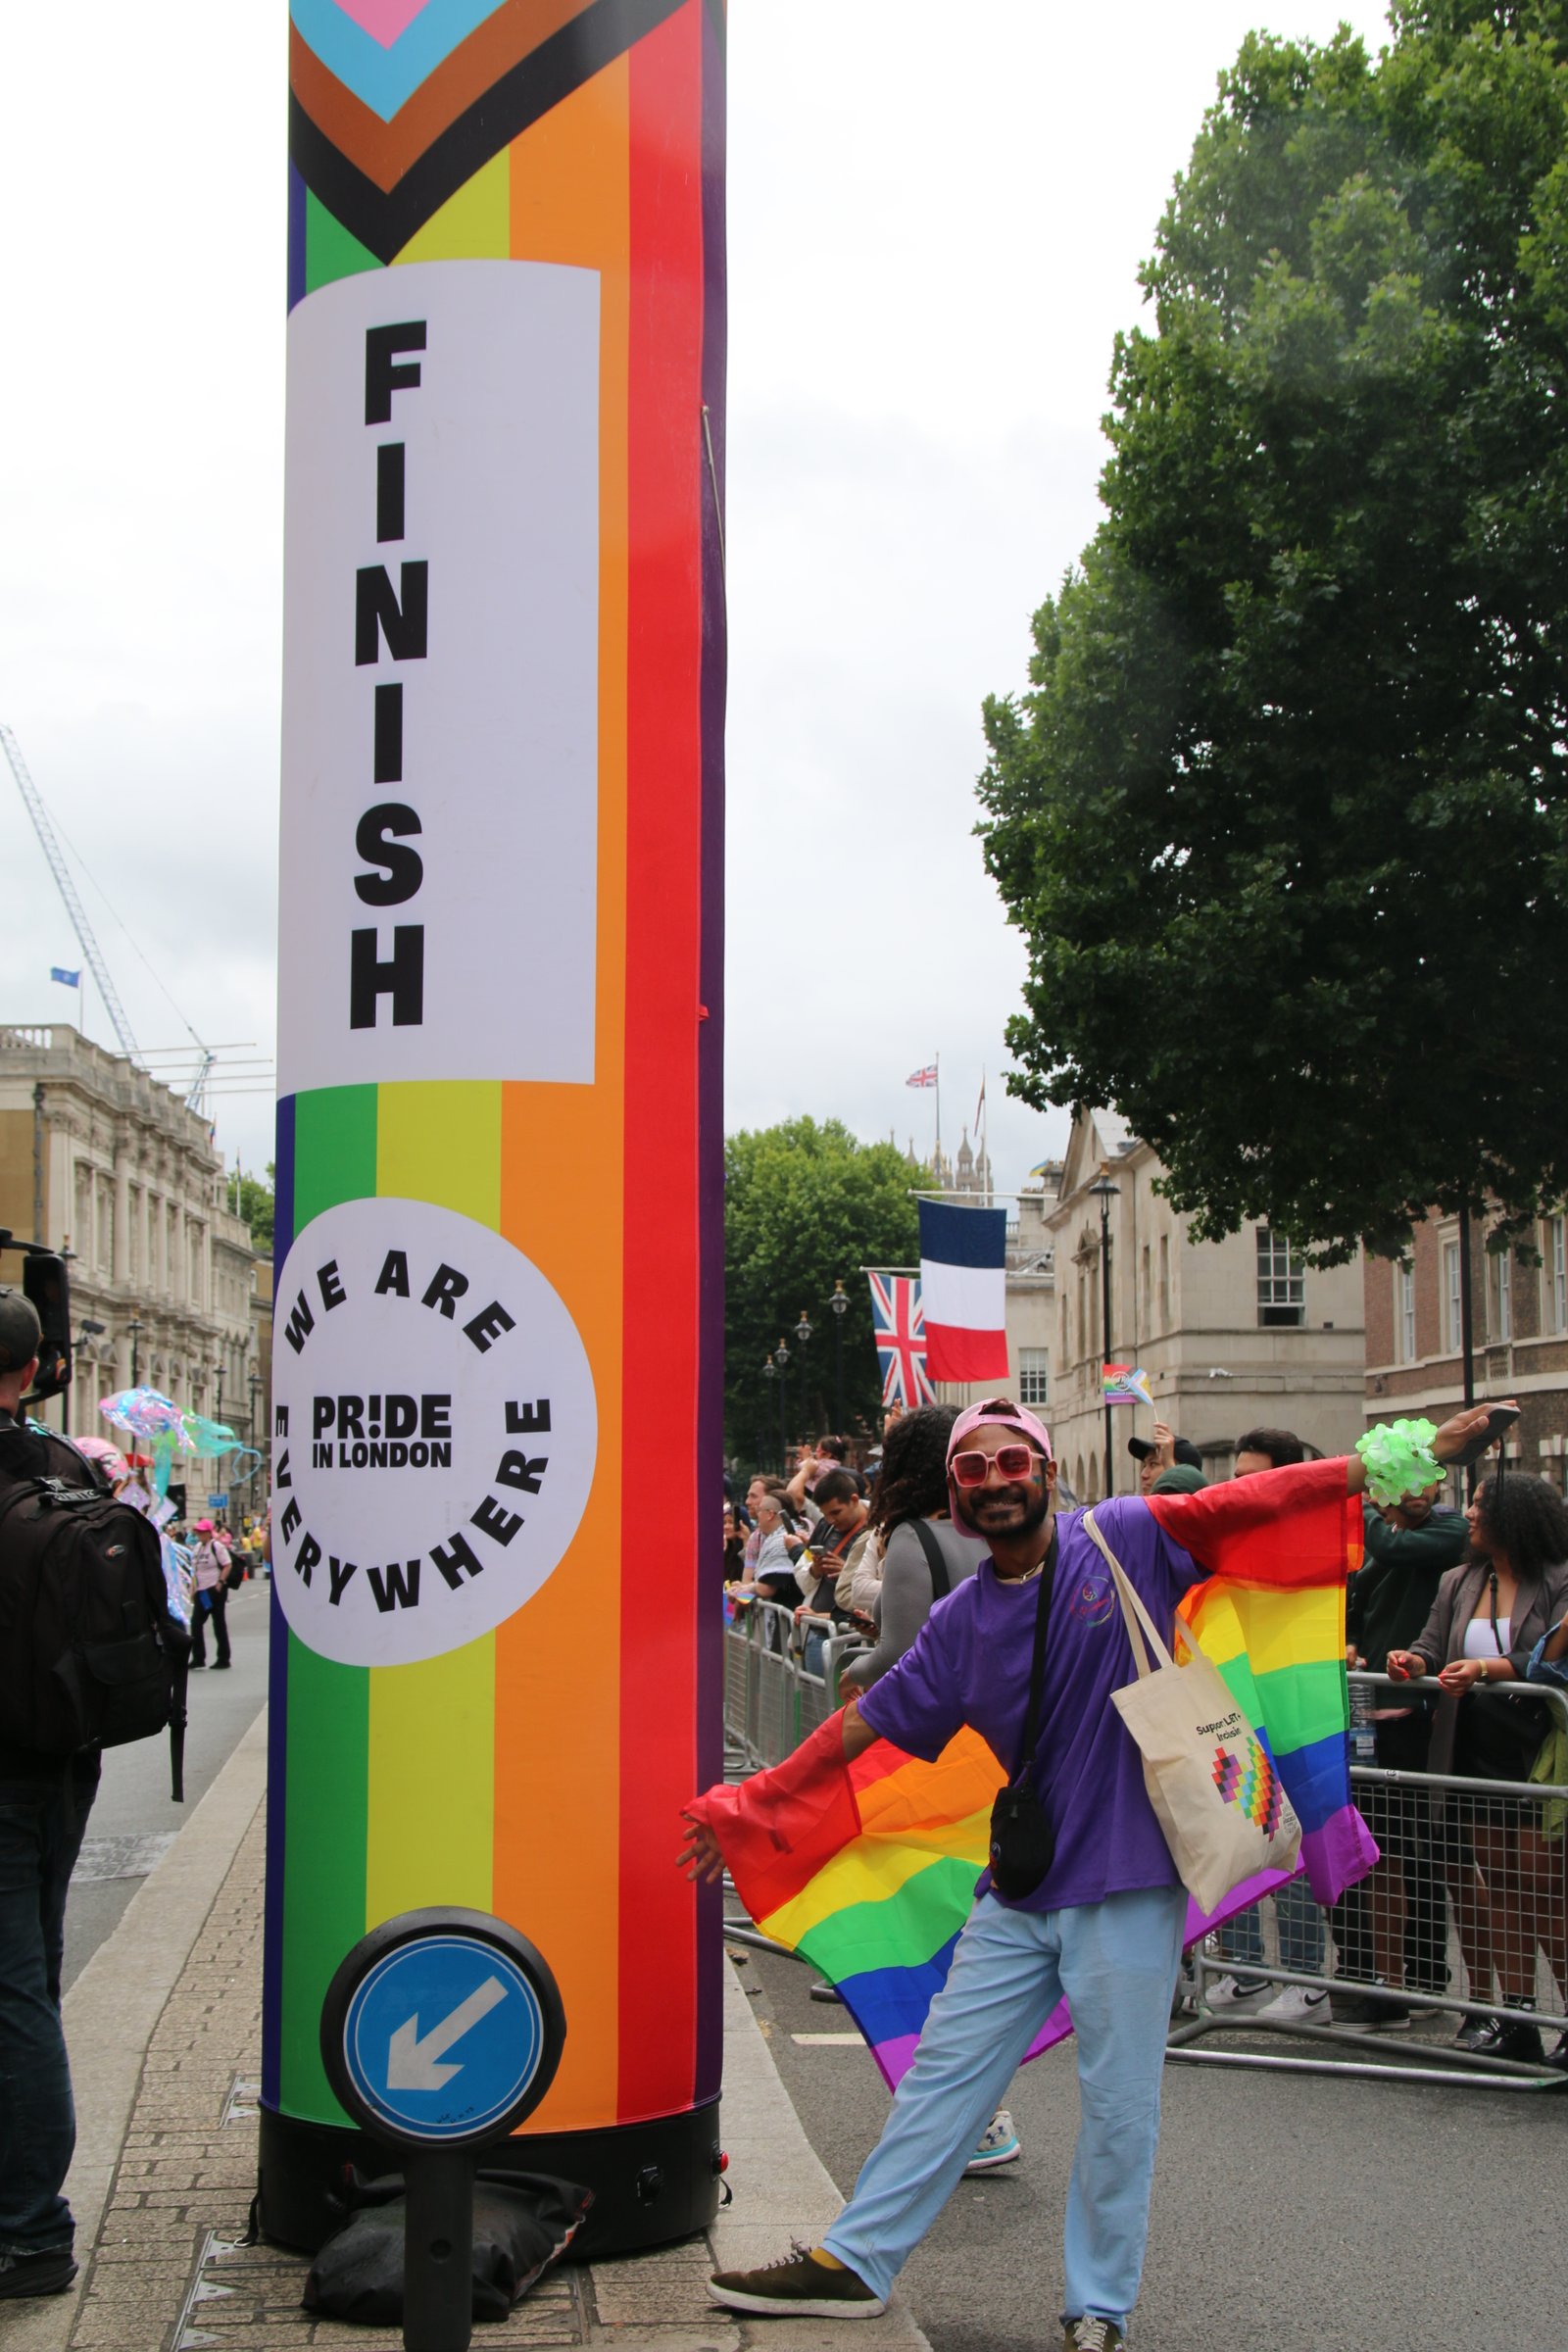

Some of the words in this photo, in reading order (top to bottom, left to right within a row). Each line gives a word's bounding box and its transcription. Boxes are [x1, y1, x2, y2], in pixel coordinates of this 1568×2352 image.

[350, 320, 428, 1030] FINISH
[284, 1259, 347, 1355] WE
[374, 1249, 516, 1354] ARE
[313, 1394, 452, 1440] PR!DE
[313, 1443, 333, 1469] IN
[339, 1442, 452, 1469] LONDON
[274, 1397, 552, 1614] EVERYWHERE
